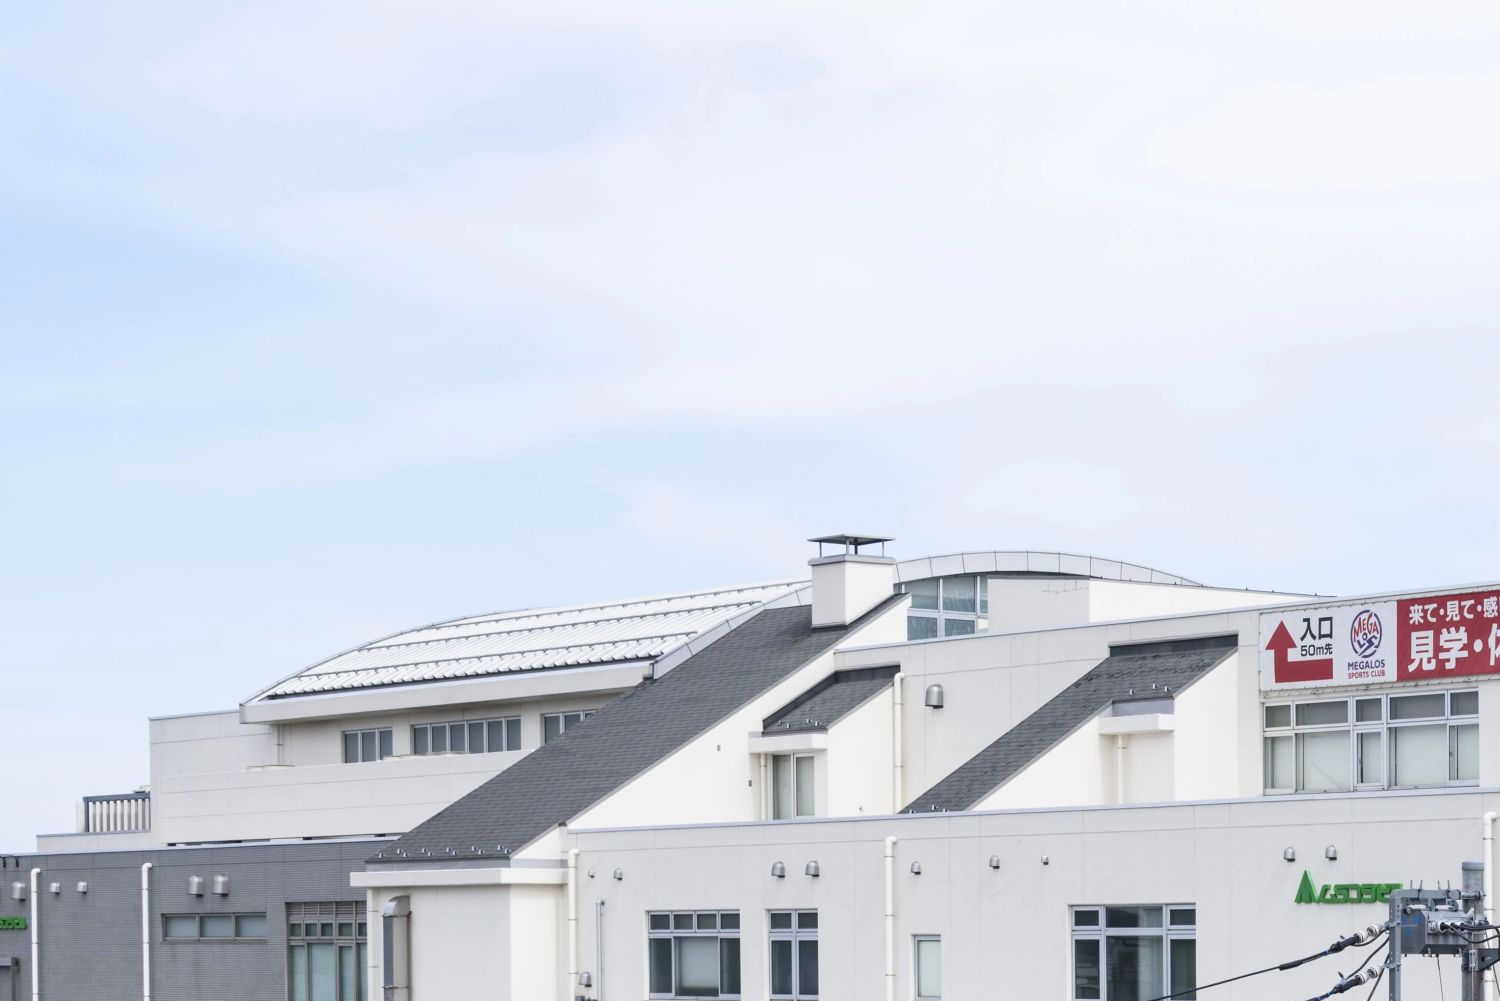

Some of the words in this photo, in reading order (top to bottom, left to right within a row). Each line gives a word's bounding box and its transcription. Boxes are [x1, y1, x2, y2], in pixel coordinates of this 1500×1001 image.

[1300, 616, 1334, 641] 入口
[1300, 643, 1333, 657] 50m先
[1347, 659, 1386, 671] MEGALOS
[1348, 671, 1370, 680] SPORTS
[1370, 670, 1386, 678] CLUB
